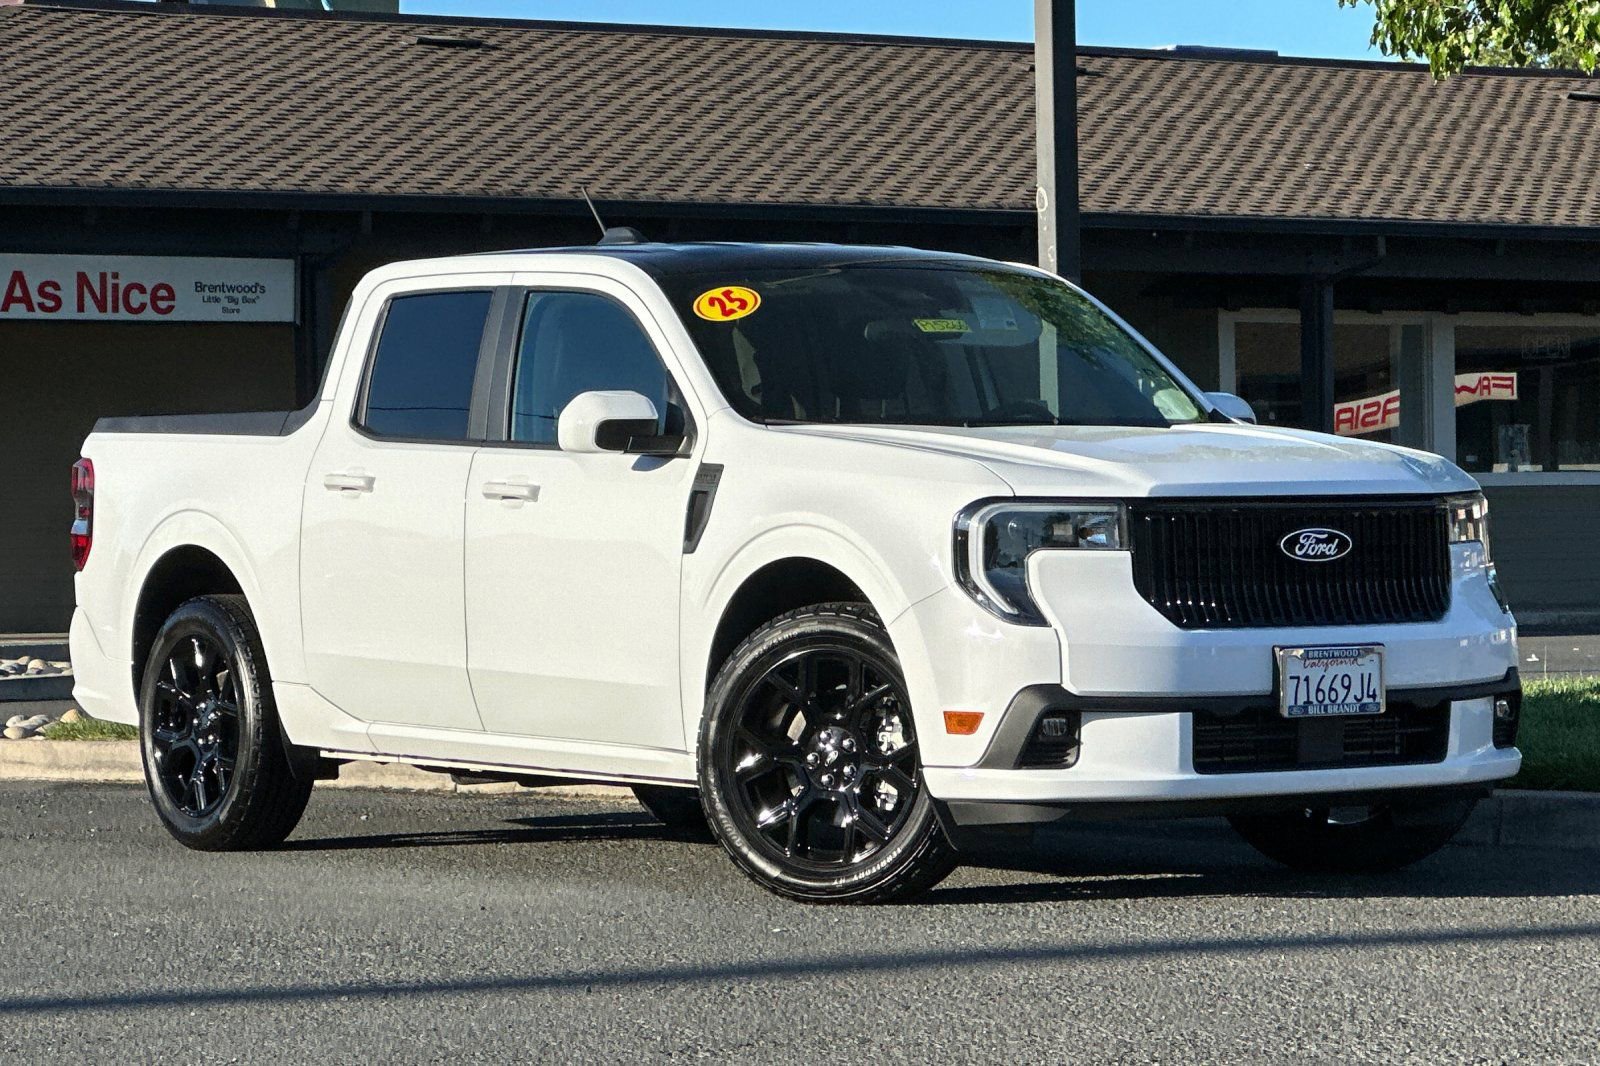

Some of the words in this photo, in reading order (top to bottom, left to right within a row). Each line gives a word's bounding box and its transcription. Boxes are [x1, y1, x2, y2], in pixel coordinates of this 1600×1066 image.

[0, 270, 63, 313] As
[77, 271, 176, 315] Nice
[195, 281, 266, 294] Brentwood's
[708, 289, 748, 317] 25
[221, 306, 240, 314] Store
[1295, 532, 1339, 555] Ford
[1308, 649, 1359, 659] BRENTWOOD
[1303, 659, 1364, 672] California
[1289, 673, 1377, 705] 71669J4
[1308, 703, 1325, 714] BILL
[1327, 703, 1361, 713] BRANDT
